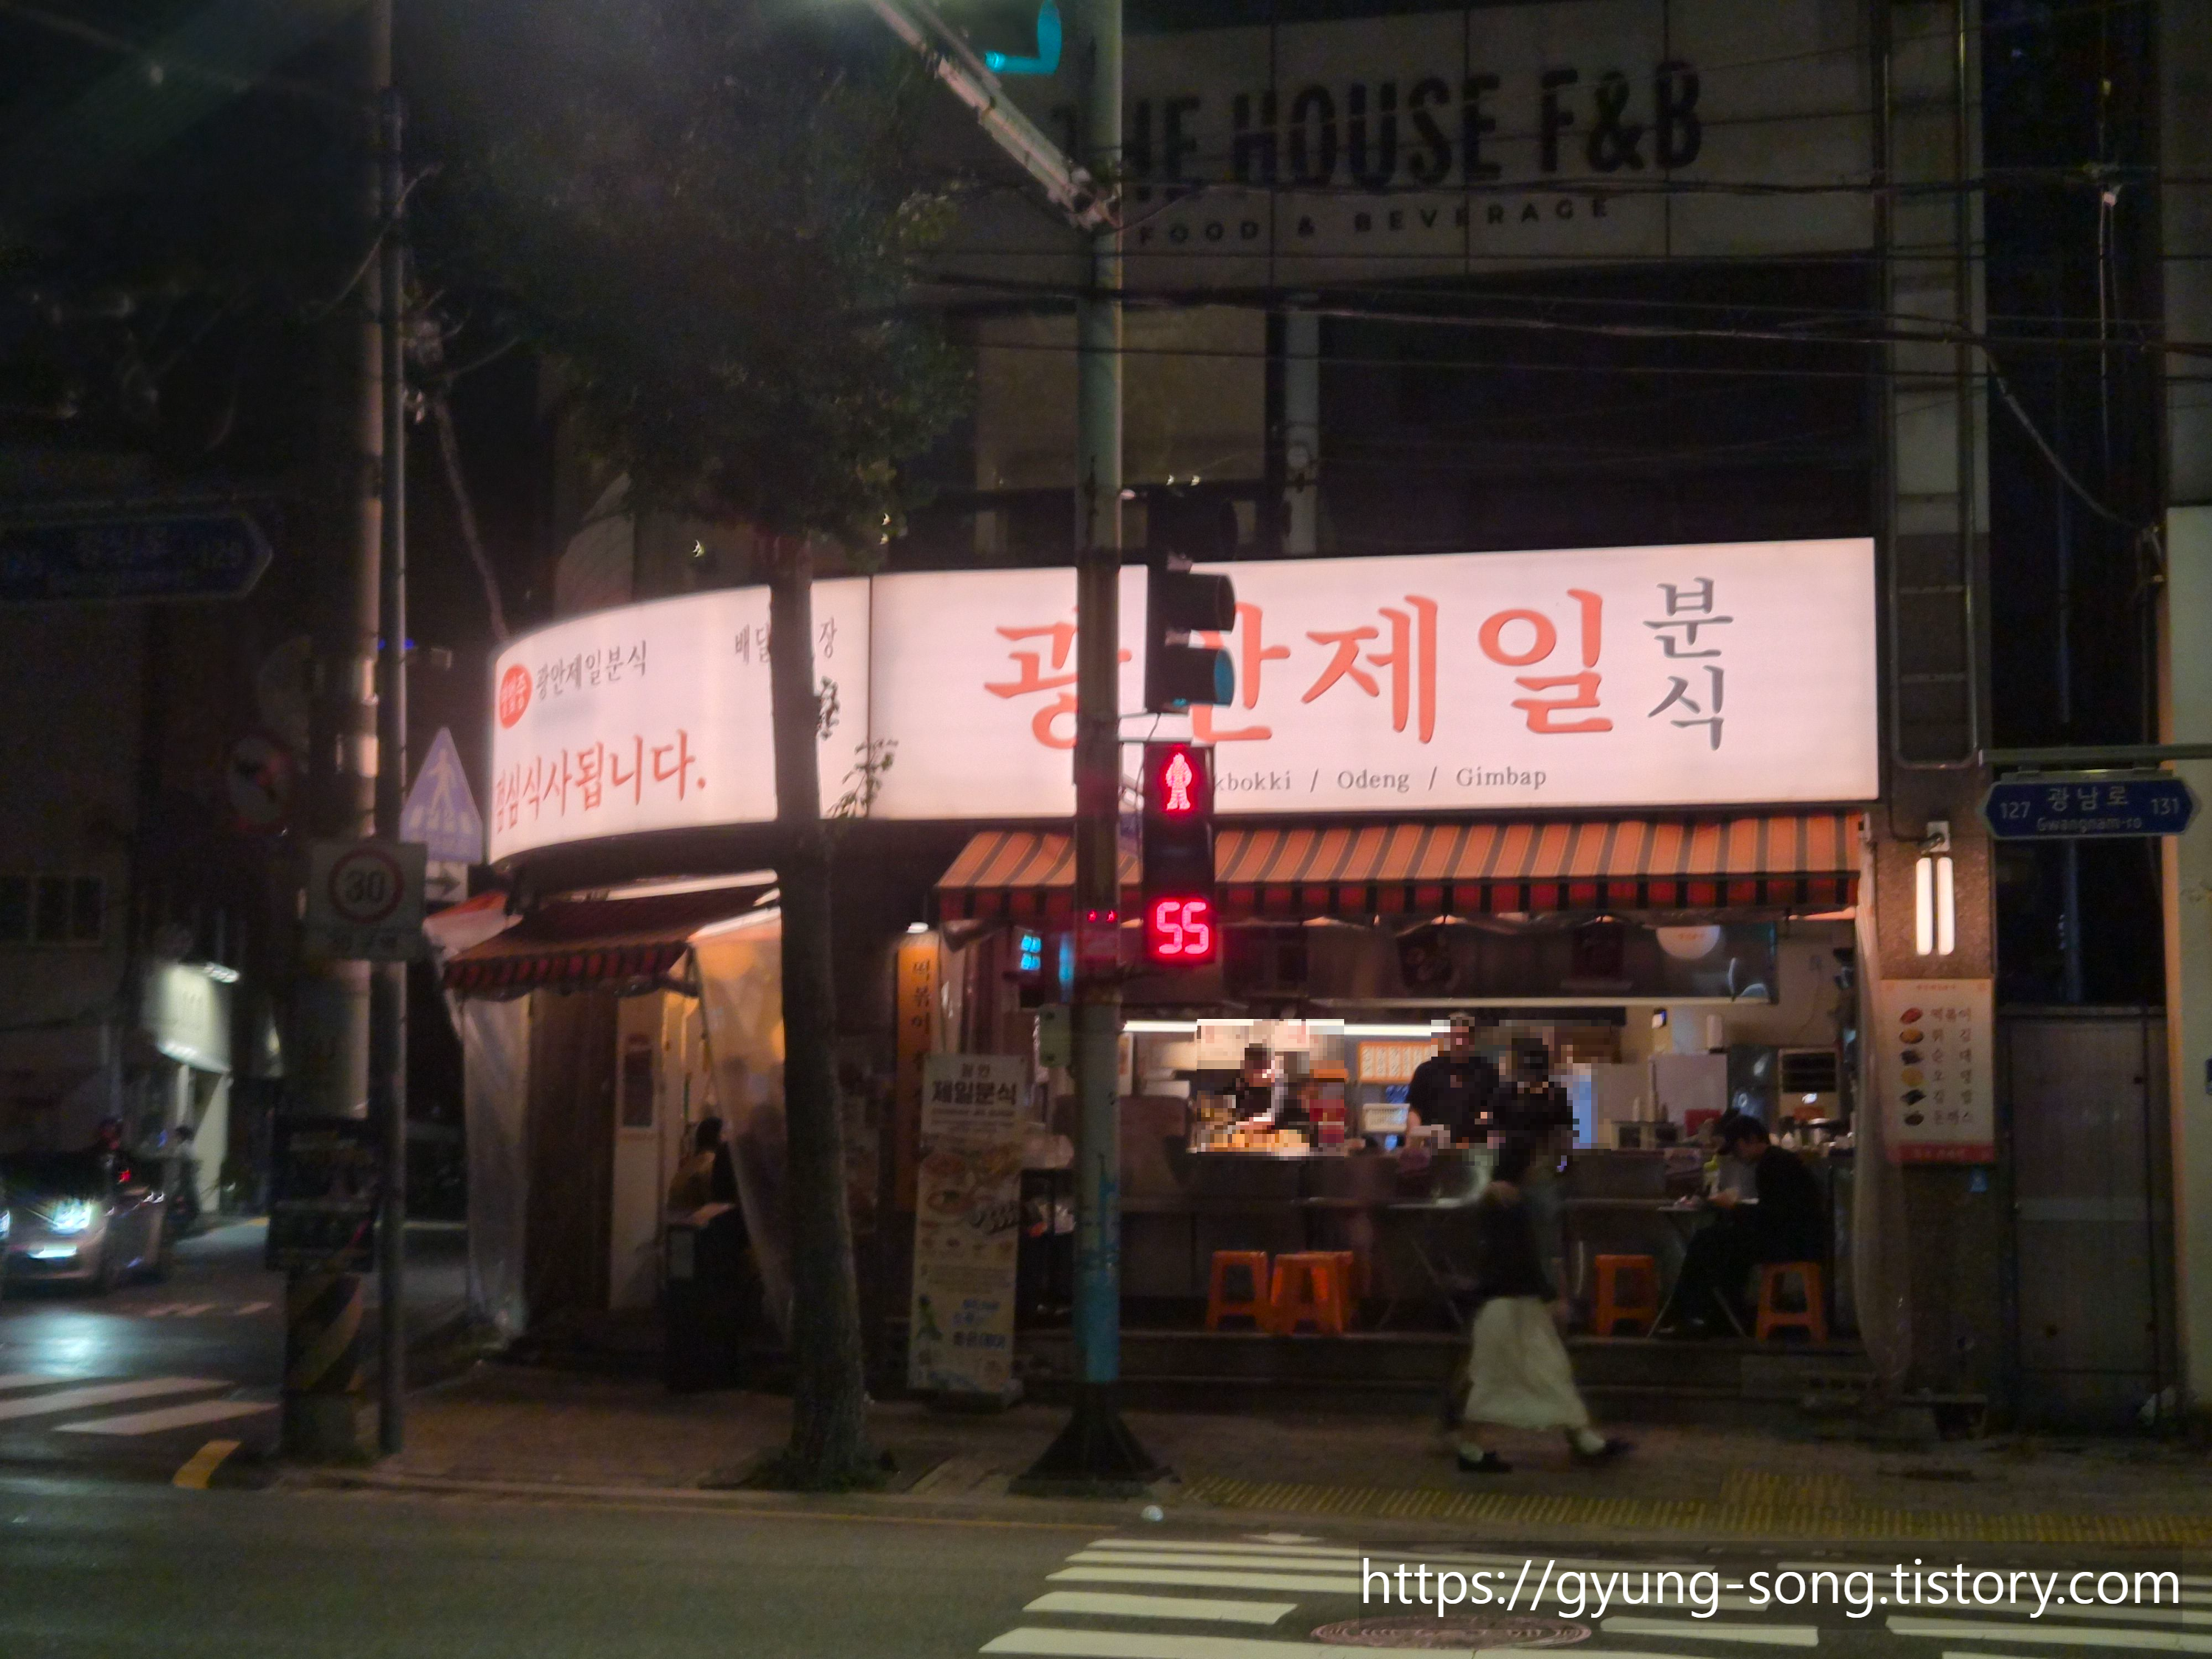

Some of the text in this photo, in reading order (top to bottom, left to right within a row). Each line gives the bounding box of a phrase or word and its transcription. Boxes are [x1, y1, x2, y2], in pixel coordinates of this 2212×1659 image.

[1233, 72, 1501, 190] HOUSE
[1540, 59, 1703, 173] F&B
[1139, 198, 1608, 246] FOOD & BEVERAGE
[536, 639, 647, 701] 광안제일분식
[1643, 577, 1734, 751] 분식
[1337, 768, 1410, 793] Odeng
[1455, 765, 1547, 790] Gimbap
[1999, 785, 2180, 819] 127 광남로 131
[2037, 816, 2143, 834] Gwangnam-ro
[344, 869, 387, 903] 30
[1155, 900, 1209, 955] 55
